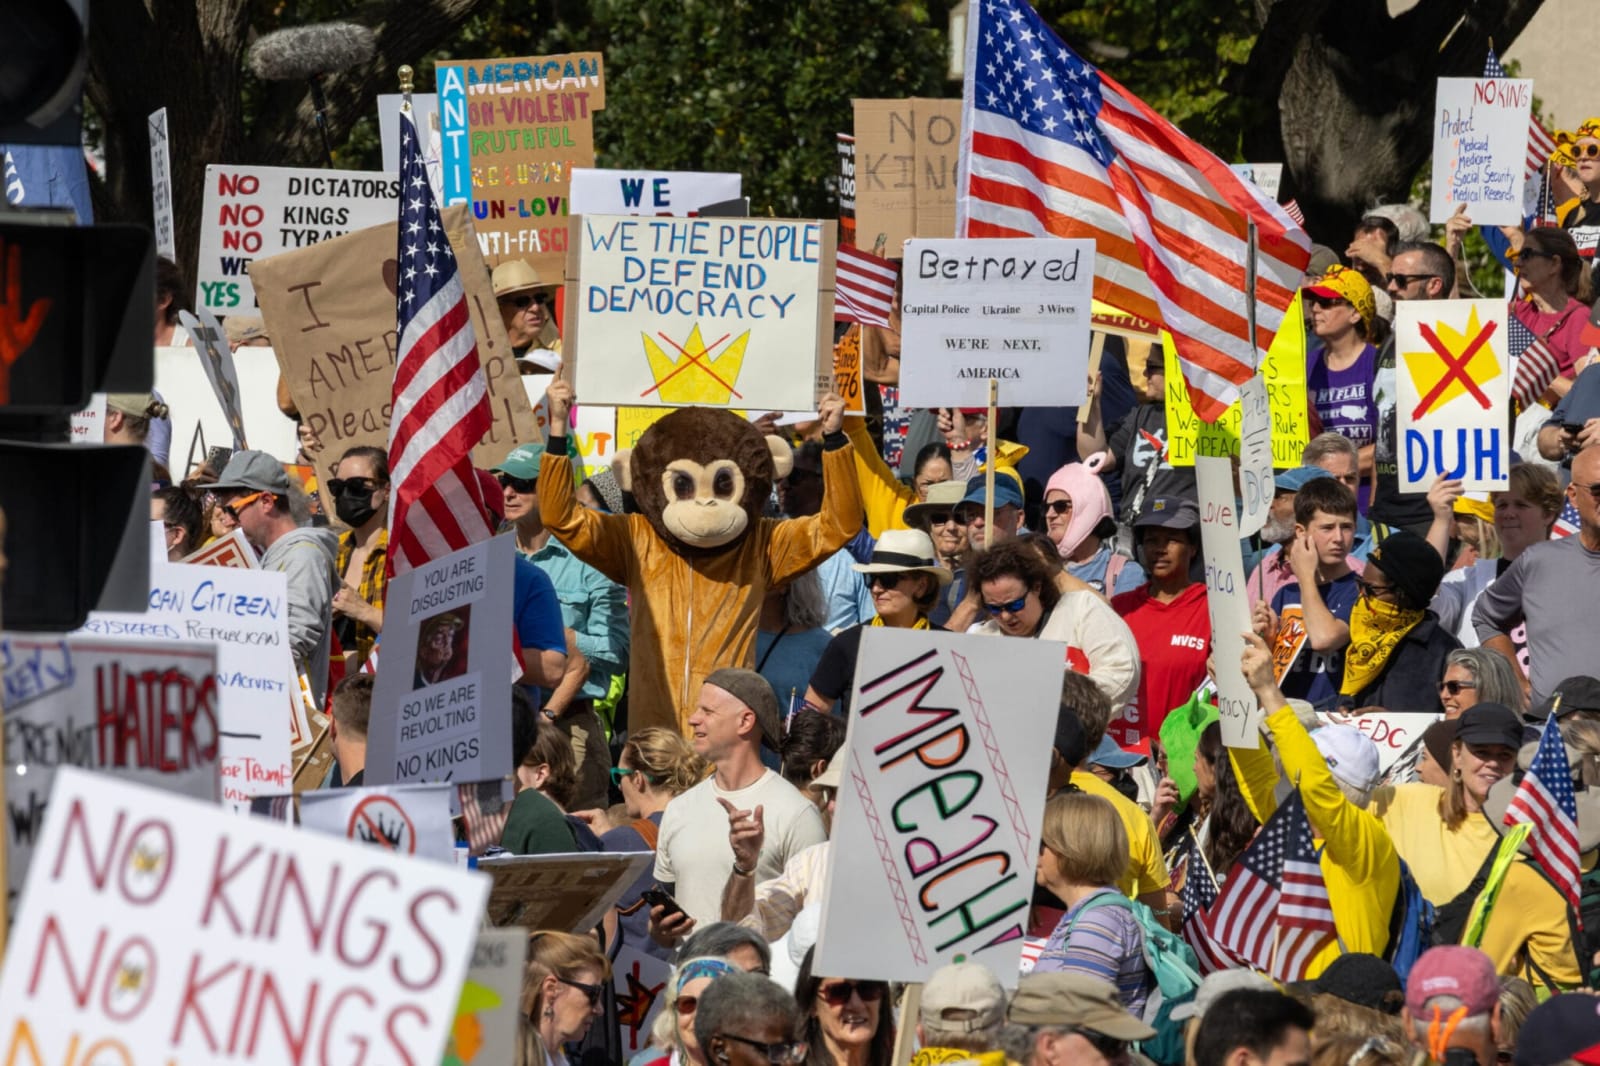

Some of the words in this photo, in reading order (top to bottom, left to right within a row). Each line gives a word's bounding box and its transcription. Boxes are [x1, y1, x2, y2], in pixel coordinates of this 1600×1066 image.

[1473, 79, 1497, 106] NO
[889, 110, 957, 146] NO
[1441, 106, 1475, 138] Protect
[1458, 134, 1489, 154] Medicaid
[864, 153, 958, 191] KIN
[1453, 167, 1481, 187] Social
[1483, 165, 1516, 193] Security
[1458, 156, 1492, 170] Medicare
[217, 172, 260, 197] NO
[287, 177, 401, 199] DICTATORS
[620, 180, 671, 207] WE
[1452, 185, 1482, 202] Medical
[1483, 186, 1516, 202] Research
[218, 203, 265, 228] NO
[282, 206, 350, 226] KINGS
[222, 230, 263, 253] NO
[586, 221, 639, 252] WE
[648, 222, 710, 255] THE
[718, 224, 820, 264] PEOPLE
[623, 256, 767, 291] DEFEND
[918, 248, 1081, 282] Betrayed
[200, 281, 241, 308] YES
[288, 281, 330, 332] I
[588, 285, 796, 320] DEMOCRACY
[903, 303, 940, 316] Capital
[941, 303, 971, 315] Police
[981, 304, 1022, 316] Ukraine
[1037, 304, 1046, 315] 3
[1046, 304, 1076, 315] Wives
[945, 337, 991, 351] WE'RE
[1001, 338, 1042, 352] NEXT,
[308, 329, 398, 400] AMER
[956, 367, 1021, 379] AMERICA
[306, 402, 392, 449] Pleas
[1405, 426, 1510, 484] DUH.
[424, 566, 449, 589] YOU
[450, 556, 477, 579] ARE
[411, 574, 484, 616] DISGUSTING
[1171, 634, 1205, 651] MVCS
[94, 660, 220, 774] HATERS
[402, 700, 422, 721] SO
[424, 691, 446, 712] WE
[448, 683, 477, 706] ARE
[400, 705, 476, 743] REVOLTING
[396, 754, 422, 782] NO
[425, 737, 480, 773] KINGS
[50, 797, 175, 906] NO
[199, 833, 461, 993] KINGS
[26, 913, 158, 1023] NO
[169, 951, 432, 1066] KINGS
